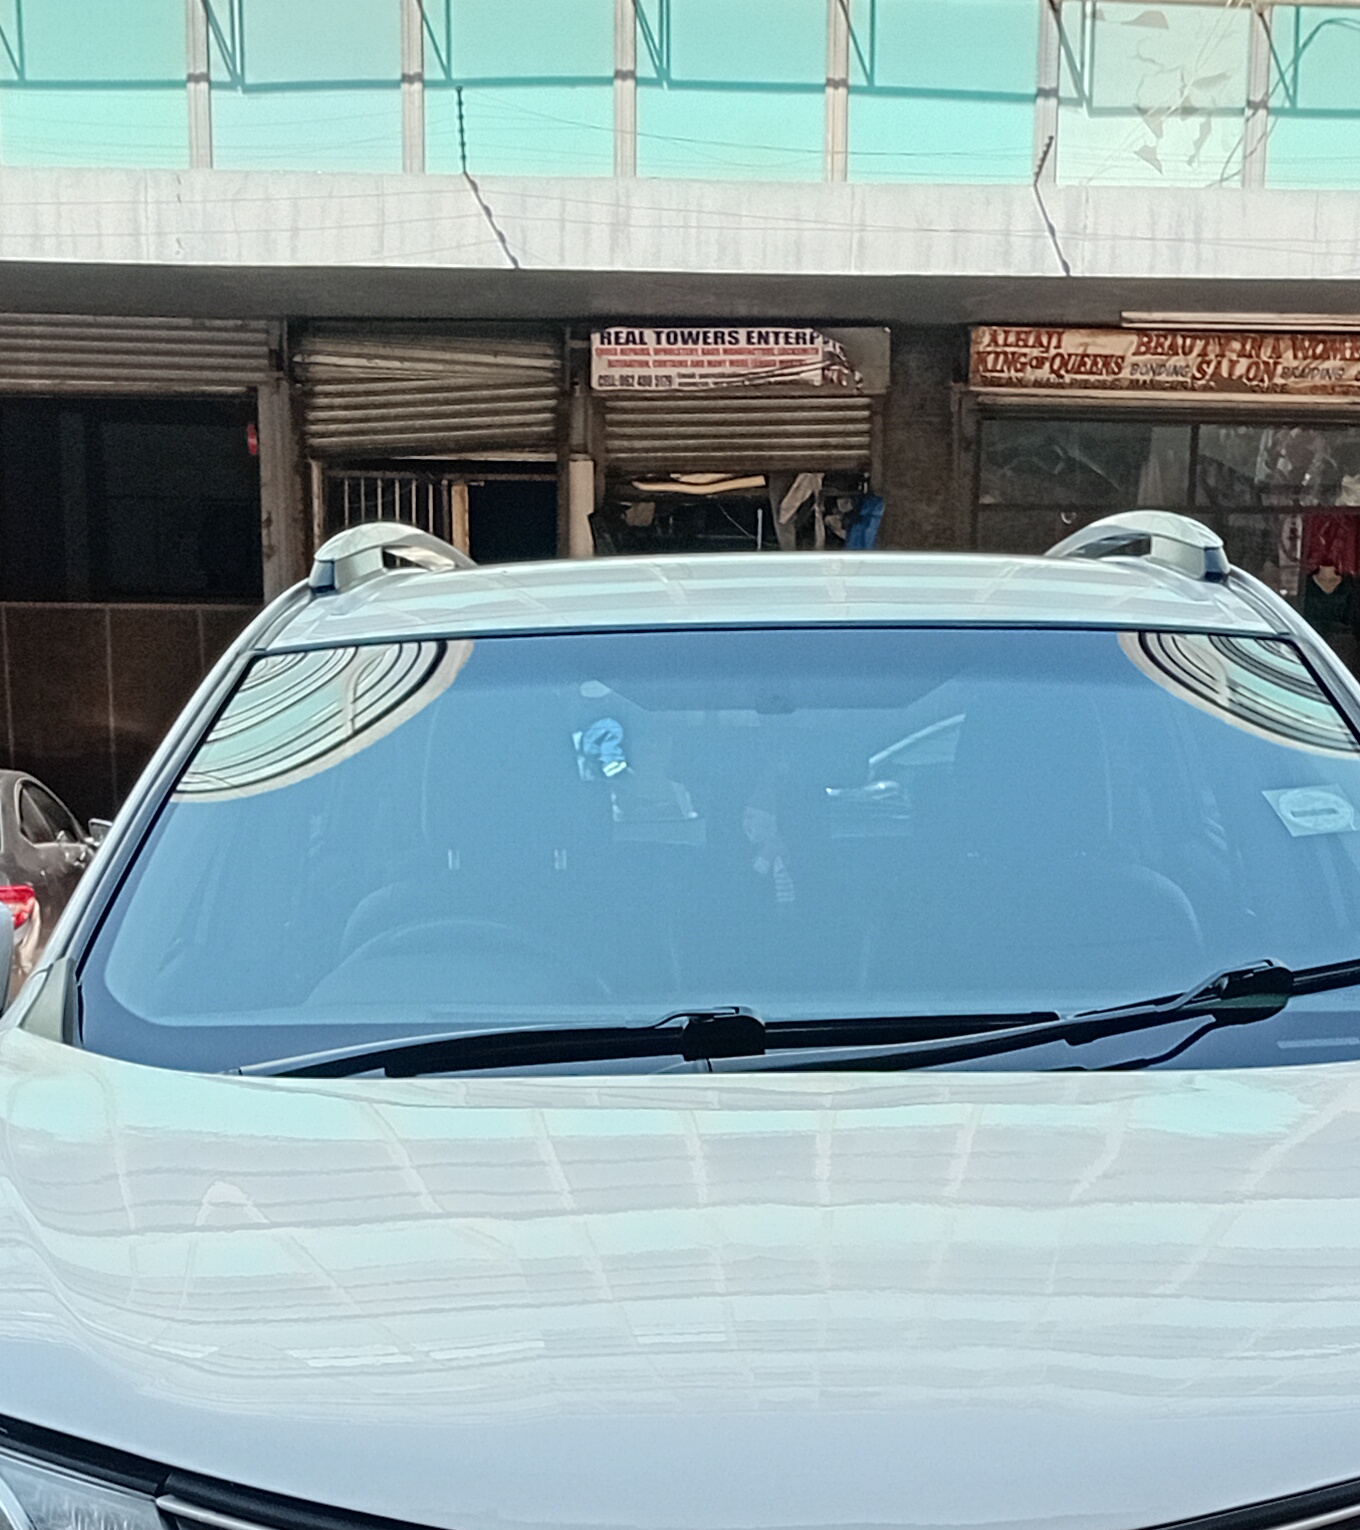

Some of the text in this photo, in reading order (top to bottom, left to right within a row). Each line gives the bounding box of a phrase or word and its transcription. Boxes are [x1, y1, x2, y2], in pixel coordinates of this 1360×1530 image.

[599, 330, 648, 346] REAL
[654, 330, 740, 346] TOWERS
[976, 351, 1028, 373] KING
[1050, 352, 1125, 378] QUEENS
